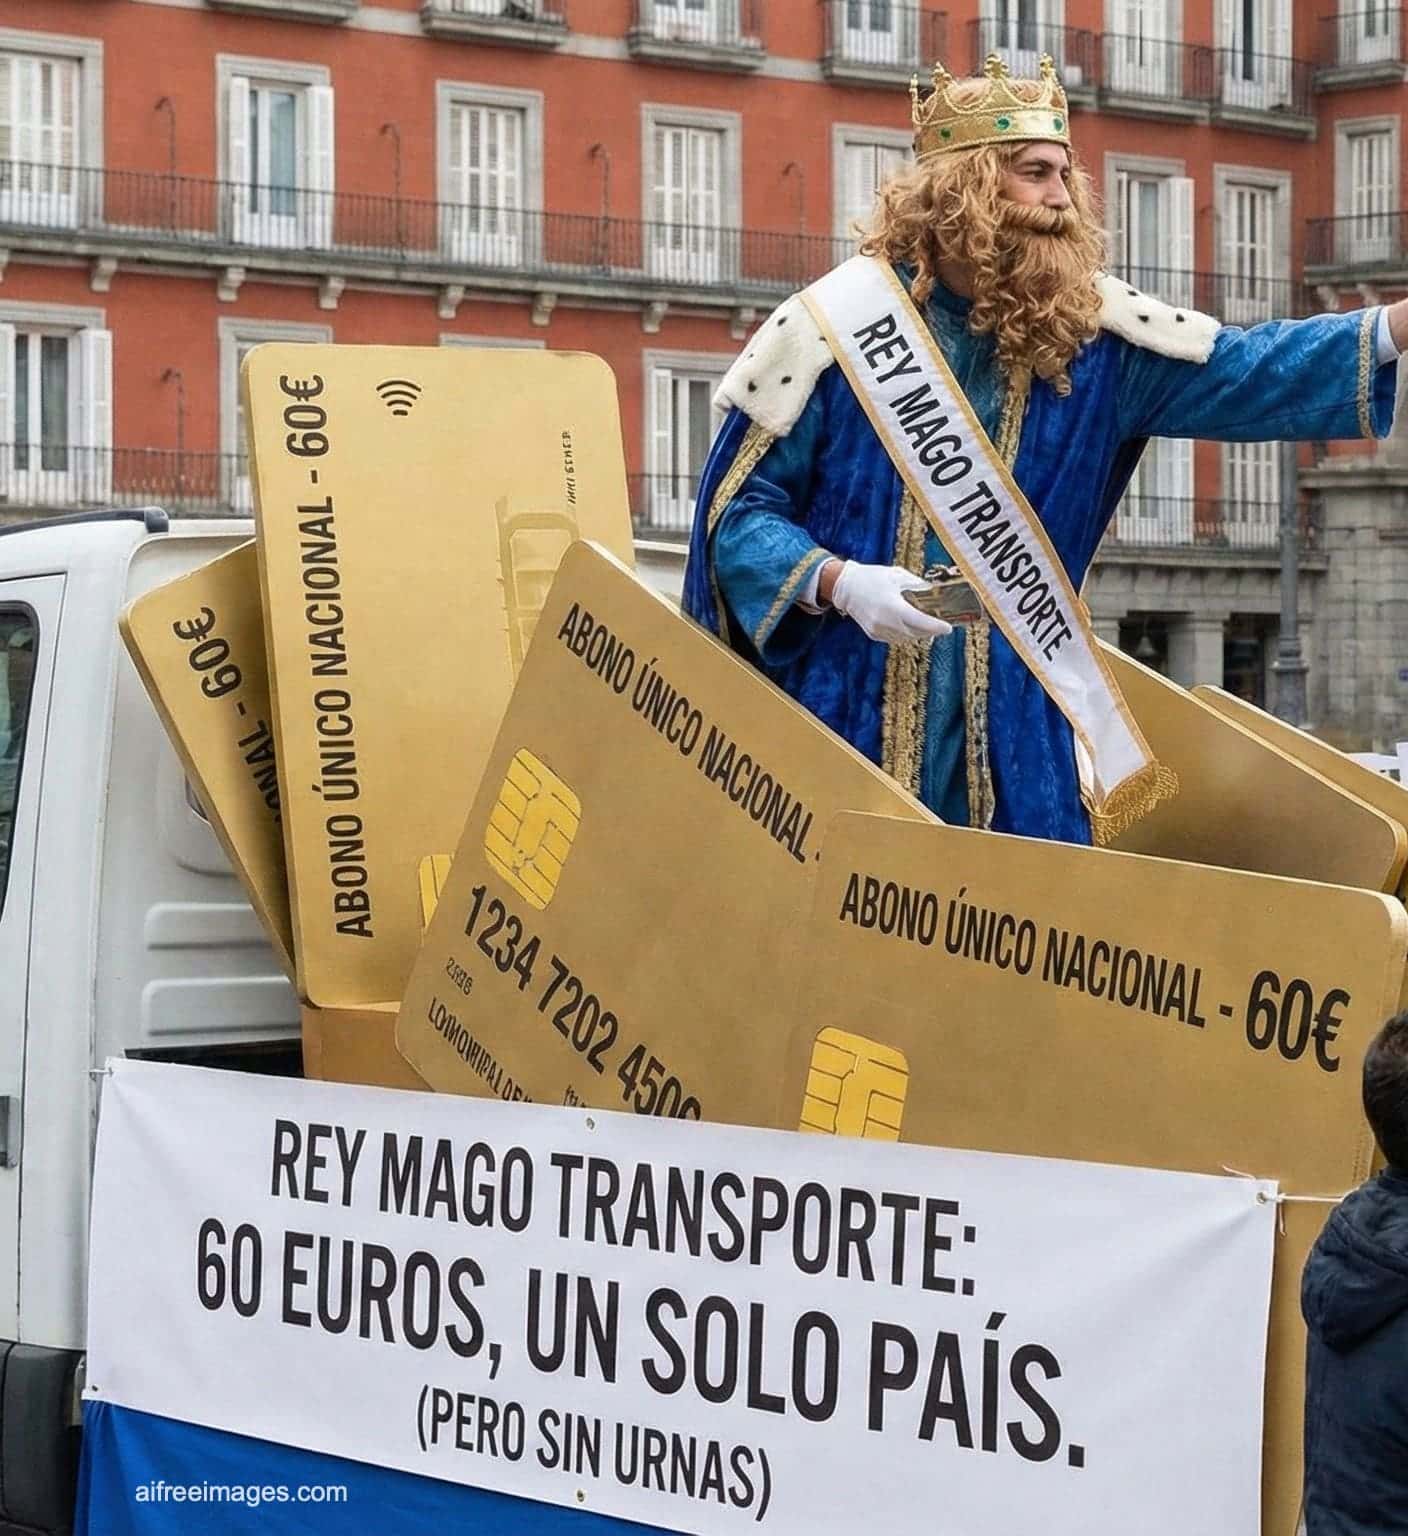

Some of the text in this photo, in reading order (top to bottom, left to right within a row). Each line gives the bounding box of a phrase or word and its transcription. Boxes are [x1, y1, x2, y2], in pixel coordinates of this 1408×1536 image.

[279, 373, 331, 458] 60€
[852, 313, 1073, 663] REY MAGO TRANSPORTE
[173, 606, 243, 699] 60€
[298, 496, 348, 676] NACIONAL
[312, 689, 360, 801] ÚNICO
[557, 602, 814, 864] ABONO ÚNICO NACIONAL
[326, 814, 374, 938] ABONO
[464, 885, 542, 991] 1234
[537, 954, 619, 1075] 7202
[839, 872, 938, 947] ABONO
[944, 887, 1035, 975] ÚNICO
[1042, 927, 1205, 1028] NACIONAL
[1245, 970, 1350, 1073] 60€
[271, 1119, 976, 1297] REY MAGO TRANSPORTE:
[198, 1217, 1086, 1468] 60 EUROS, UN SOLO PAÍS.
[416, 1384, 772, 1522] (PERO SIN URNAS)
